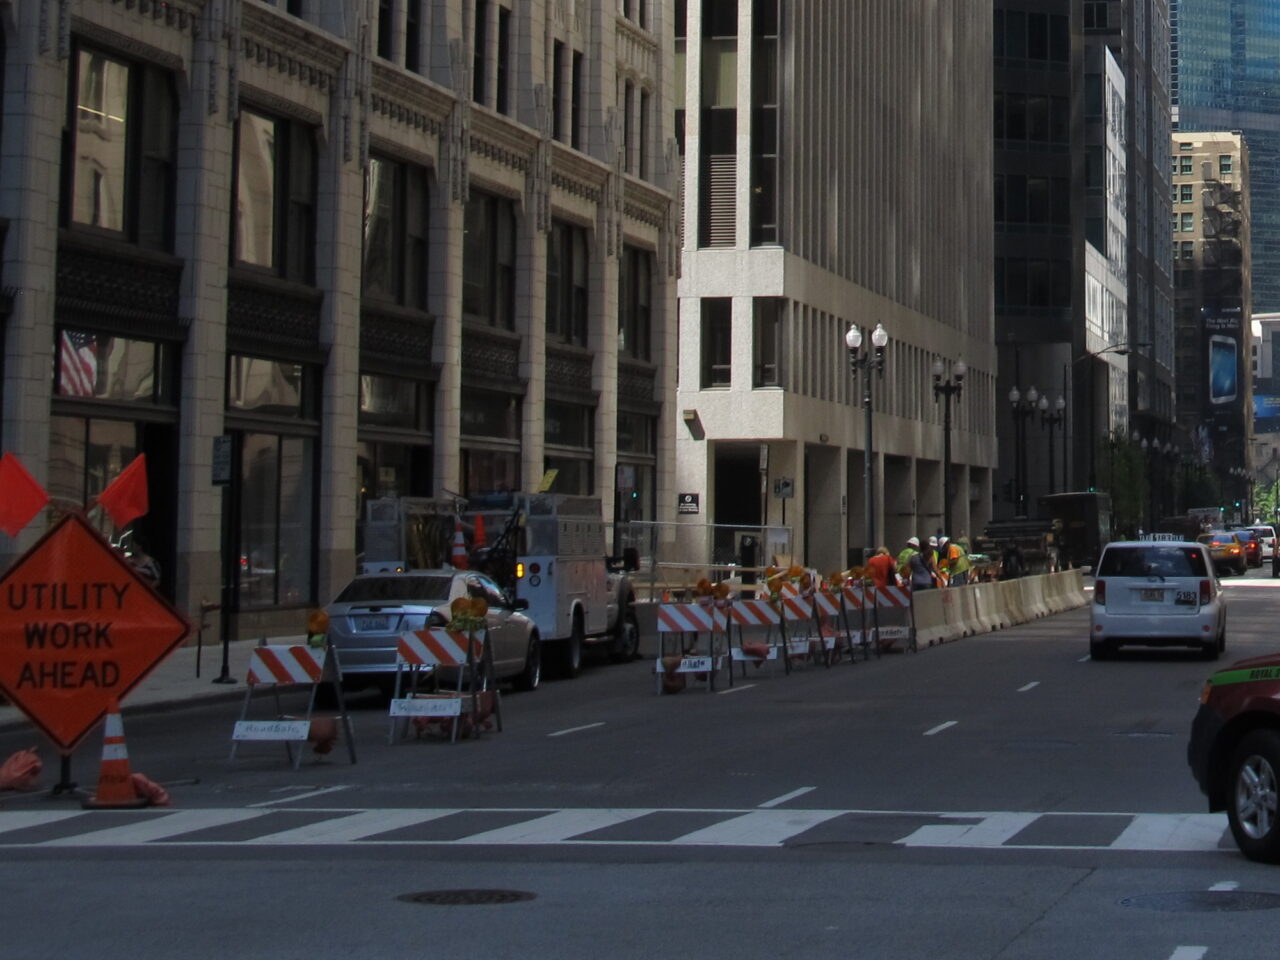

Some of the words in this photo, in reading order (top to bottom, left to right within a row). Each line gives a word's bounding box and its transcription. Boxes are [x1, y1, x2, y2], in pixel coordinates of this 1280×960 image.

[8, 582, 131, 611] UTILITY
[1176, 591, 1197, 601] 5183
[24, 622, 113, 649] WORK
[16, 661, 121, 689] AHEAD
[1249, 668, 1273, 680] ROYAL
